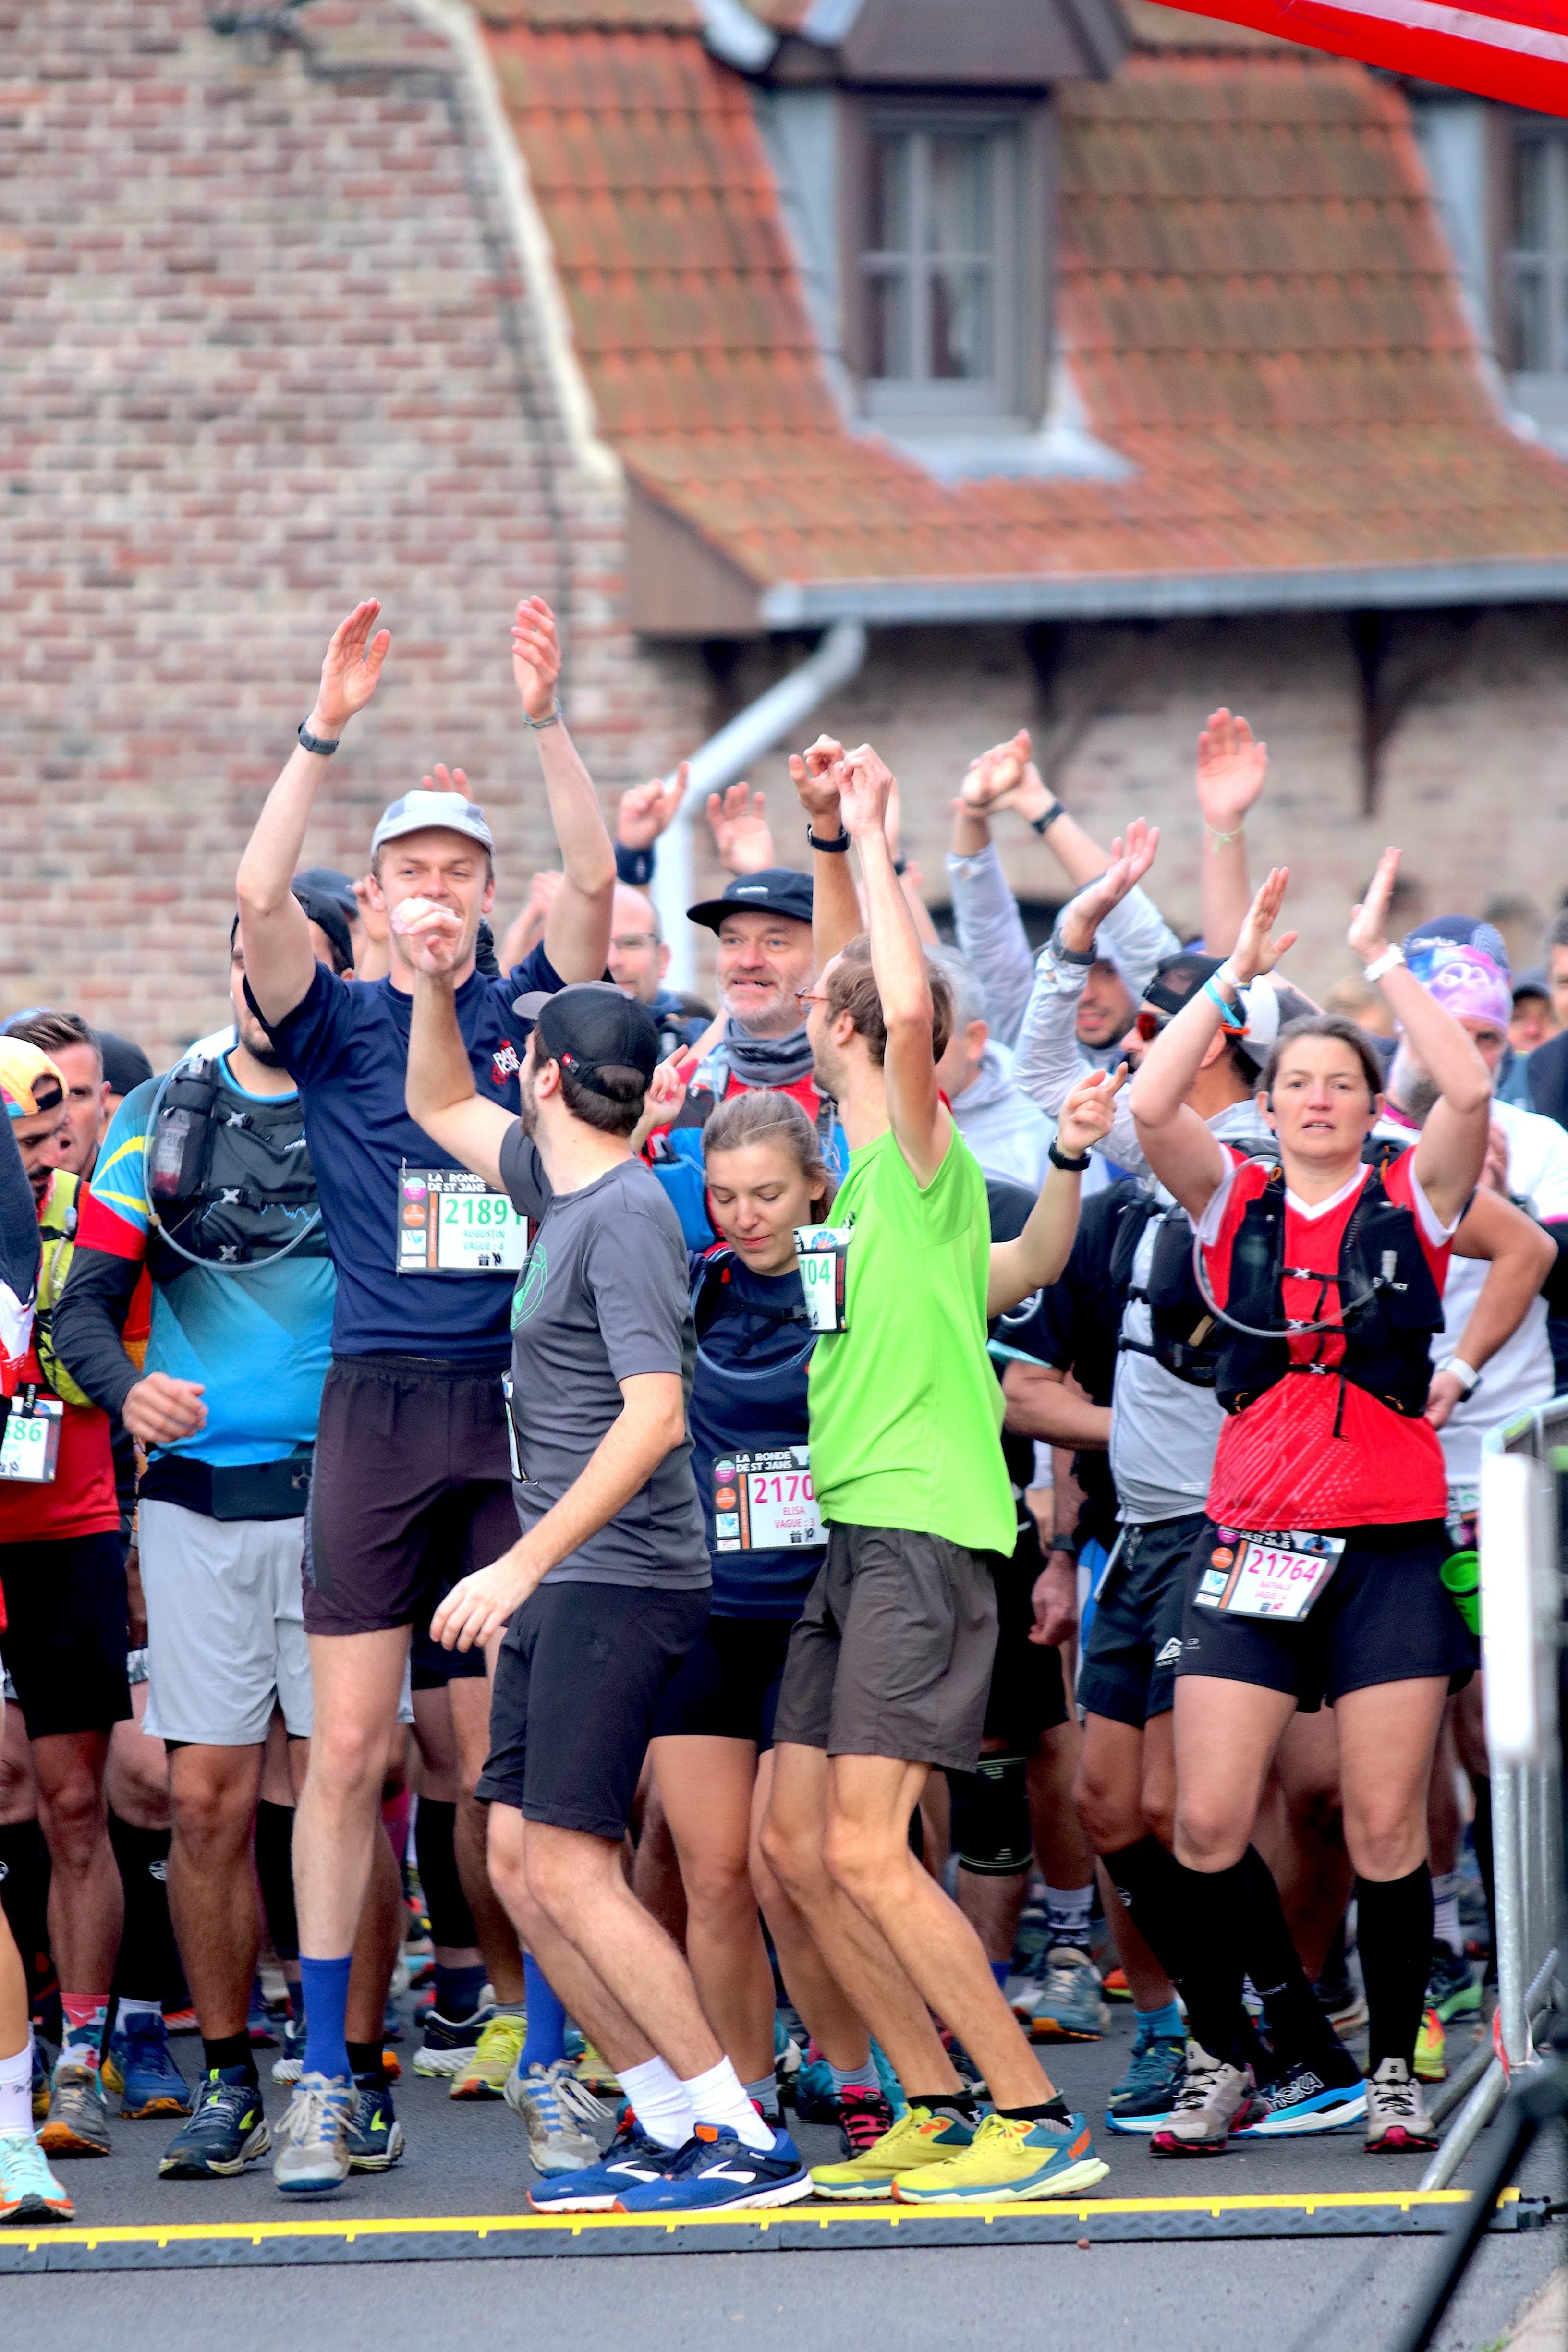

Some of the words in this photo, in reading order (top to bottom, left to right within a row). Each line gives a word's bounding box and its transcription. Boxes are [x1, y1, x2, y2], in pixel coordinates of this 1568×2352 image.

[428, 1173, 443, 1182] LA
[458, 1183, 486, 1192] JANS
[463, 1229, 505, 1239] AUGUSTIN
[463, 1242, 492, 1250] VAGUE
[736, 1454, 751, 1463] LA
[755, 1451, 792, 1462] RONDE
[765, 1460, 792, 1470] JANS
[783, 1506, 805, 1515] ELISA
[774, 1519, 802, 1528] VAGUE
[810, 1518, 814, 1526] 3
[1247, 1549, 1321, 1583] 21764
